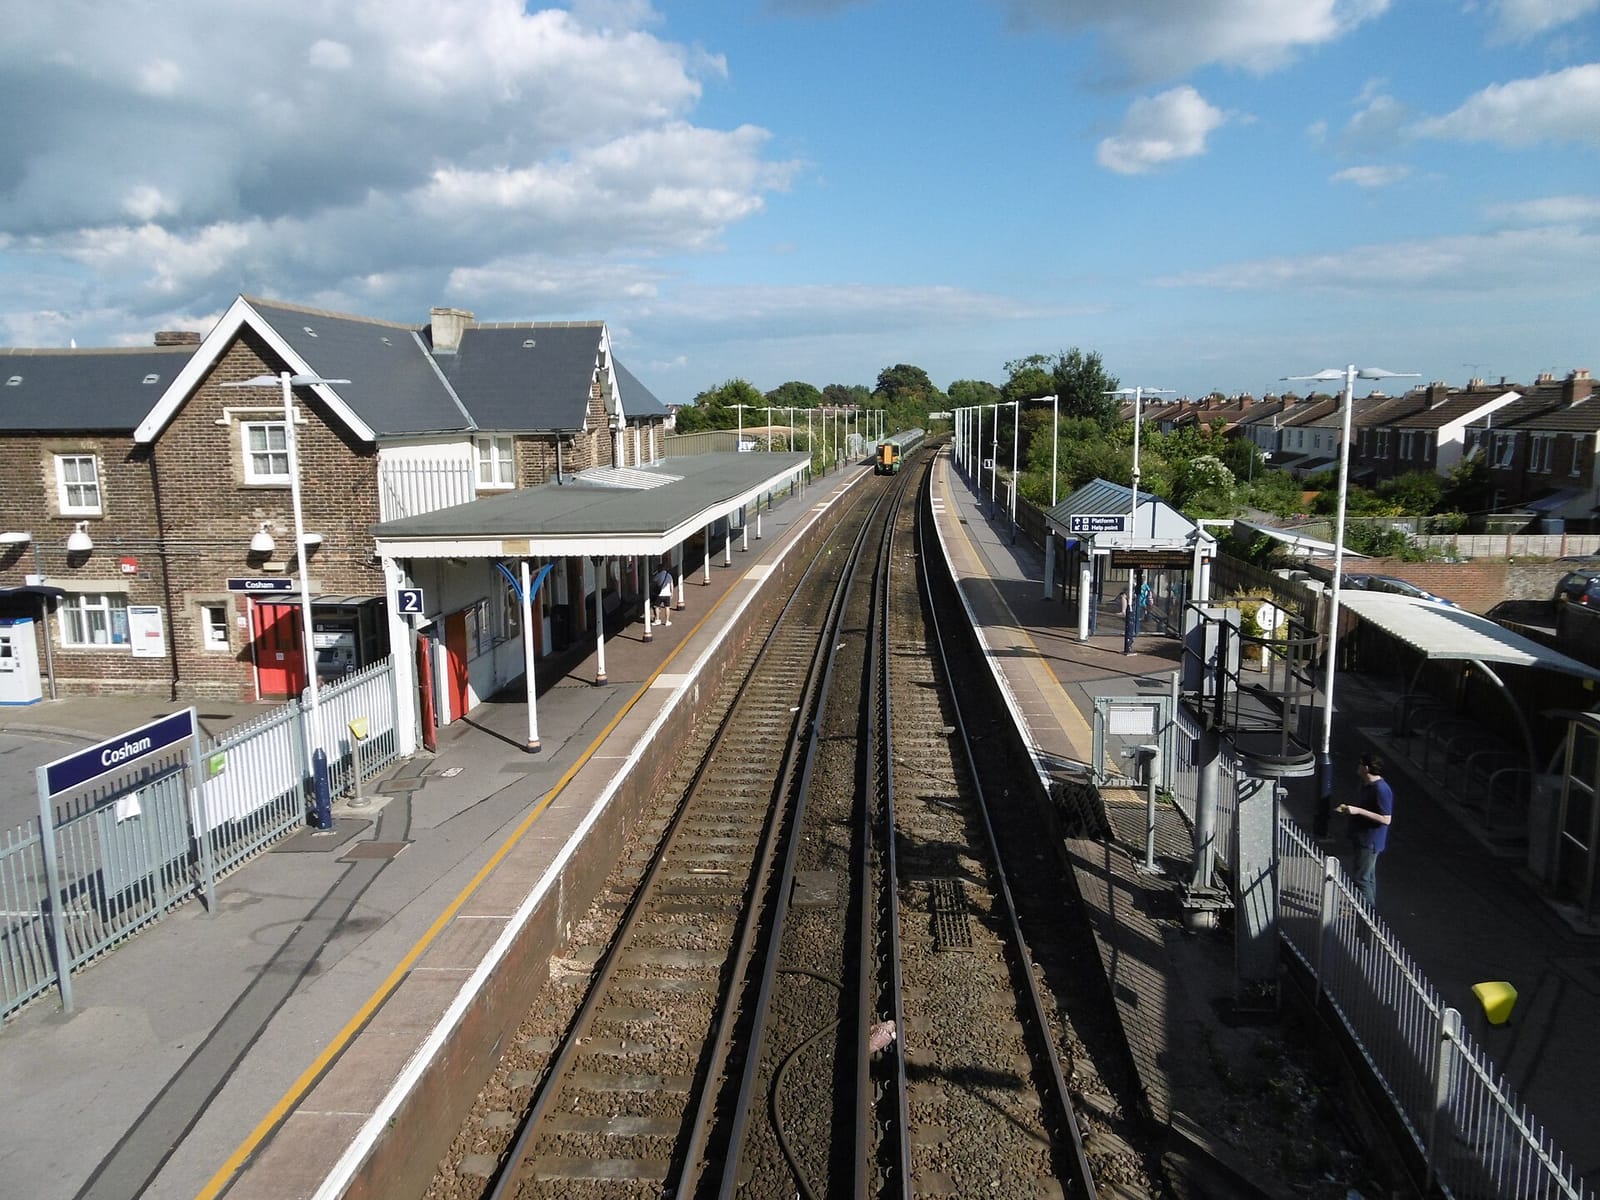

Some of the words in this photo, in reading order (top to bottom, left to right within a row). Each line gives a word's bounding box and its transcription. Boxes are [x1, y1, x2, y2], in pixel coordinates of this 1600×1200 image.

[245, 581, 274, 589] Cosham
[404, 591, 418, 610] 2
[101, 736, 151, 766] Cosham
